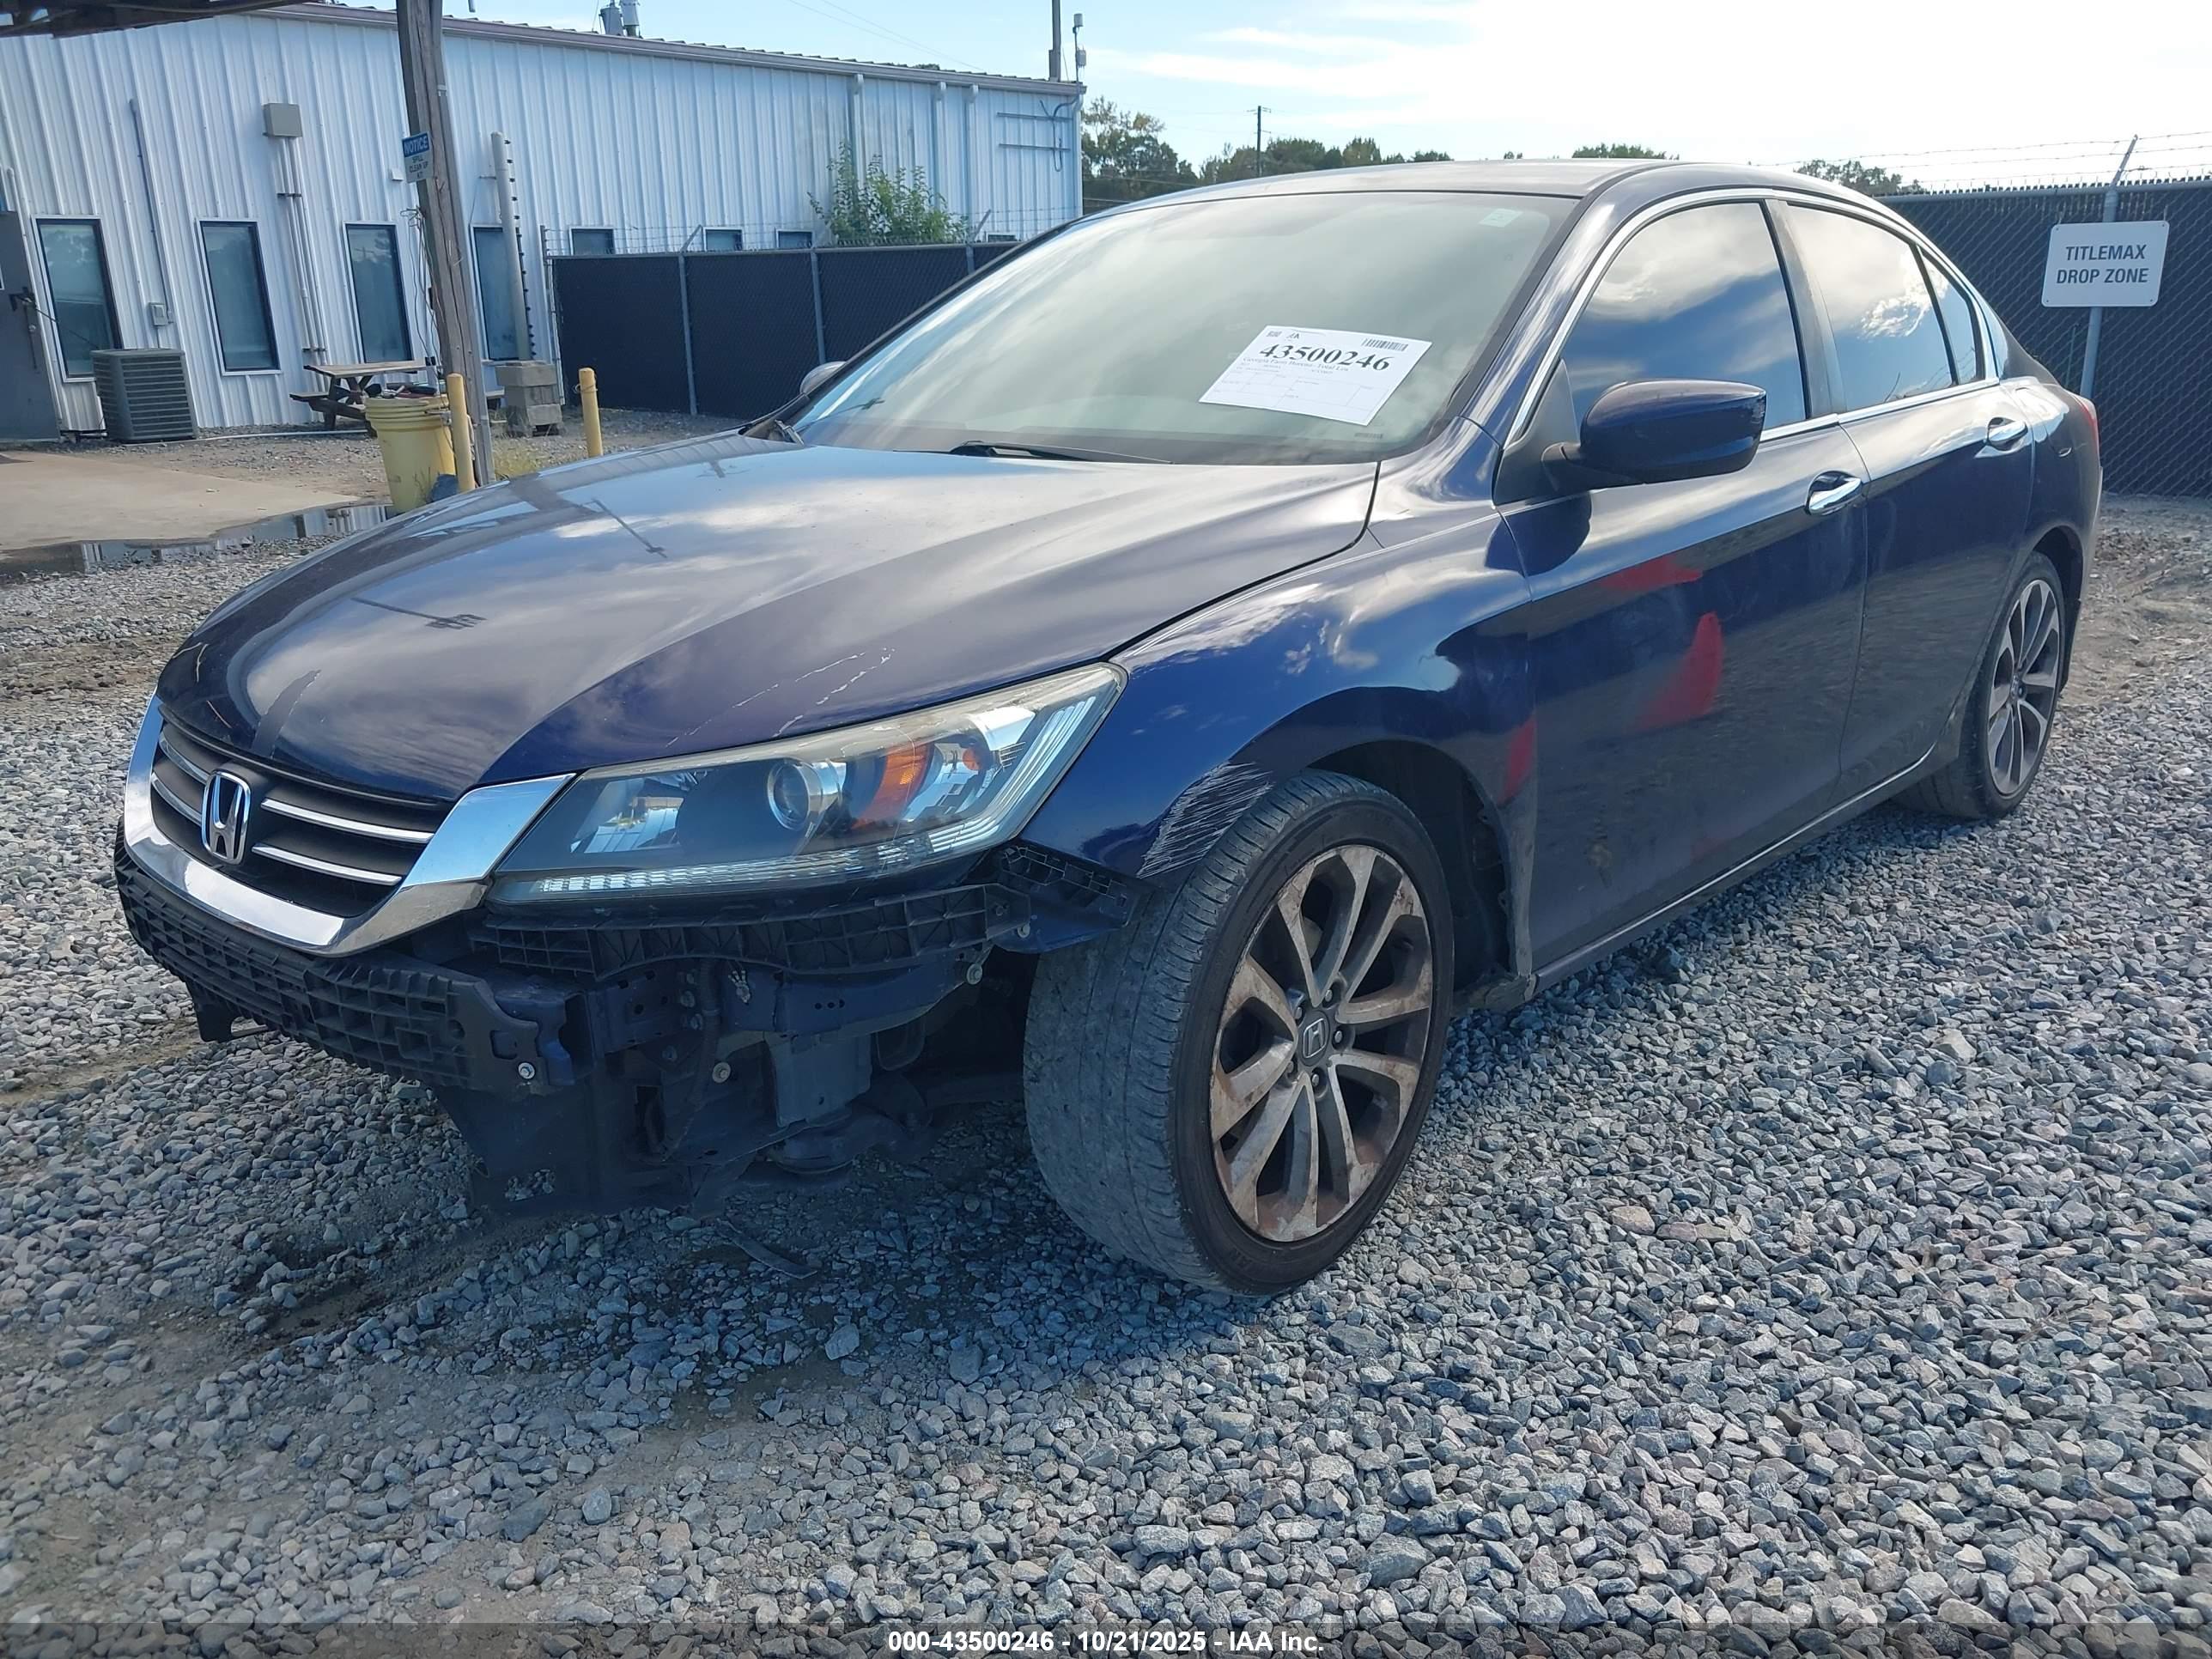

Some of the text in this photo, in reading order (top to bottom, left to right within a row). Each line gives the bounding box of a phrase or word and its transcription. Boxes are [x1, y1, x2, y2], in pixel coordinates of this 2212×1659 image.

[404, 136, 428, 155] NOTICE
[2065, 244, 2148, 261] TITLEMAX
[2056, 268, 2149, 284] DROP ZONE
[1259, 343, 1395, 371] 43500246
